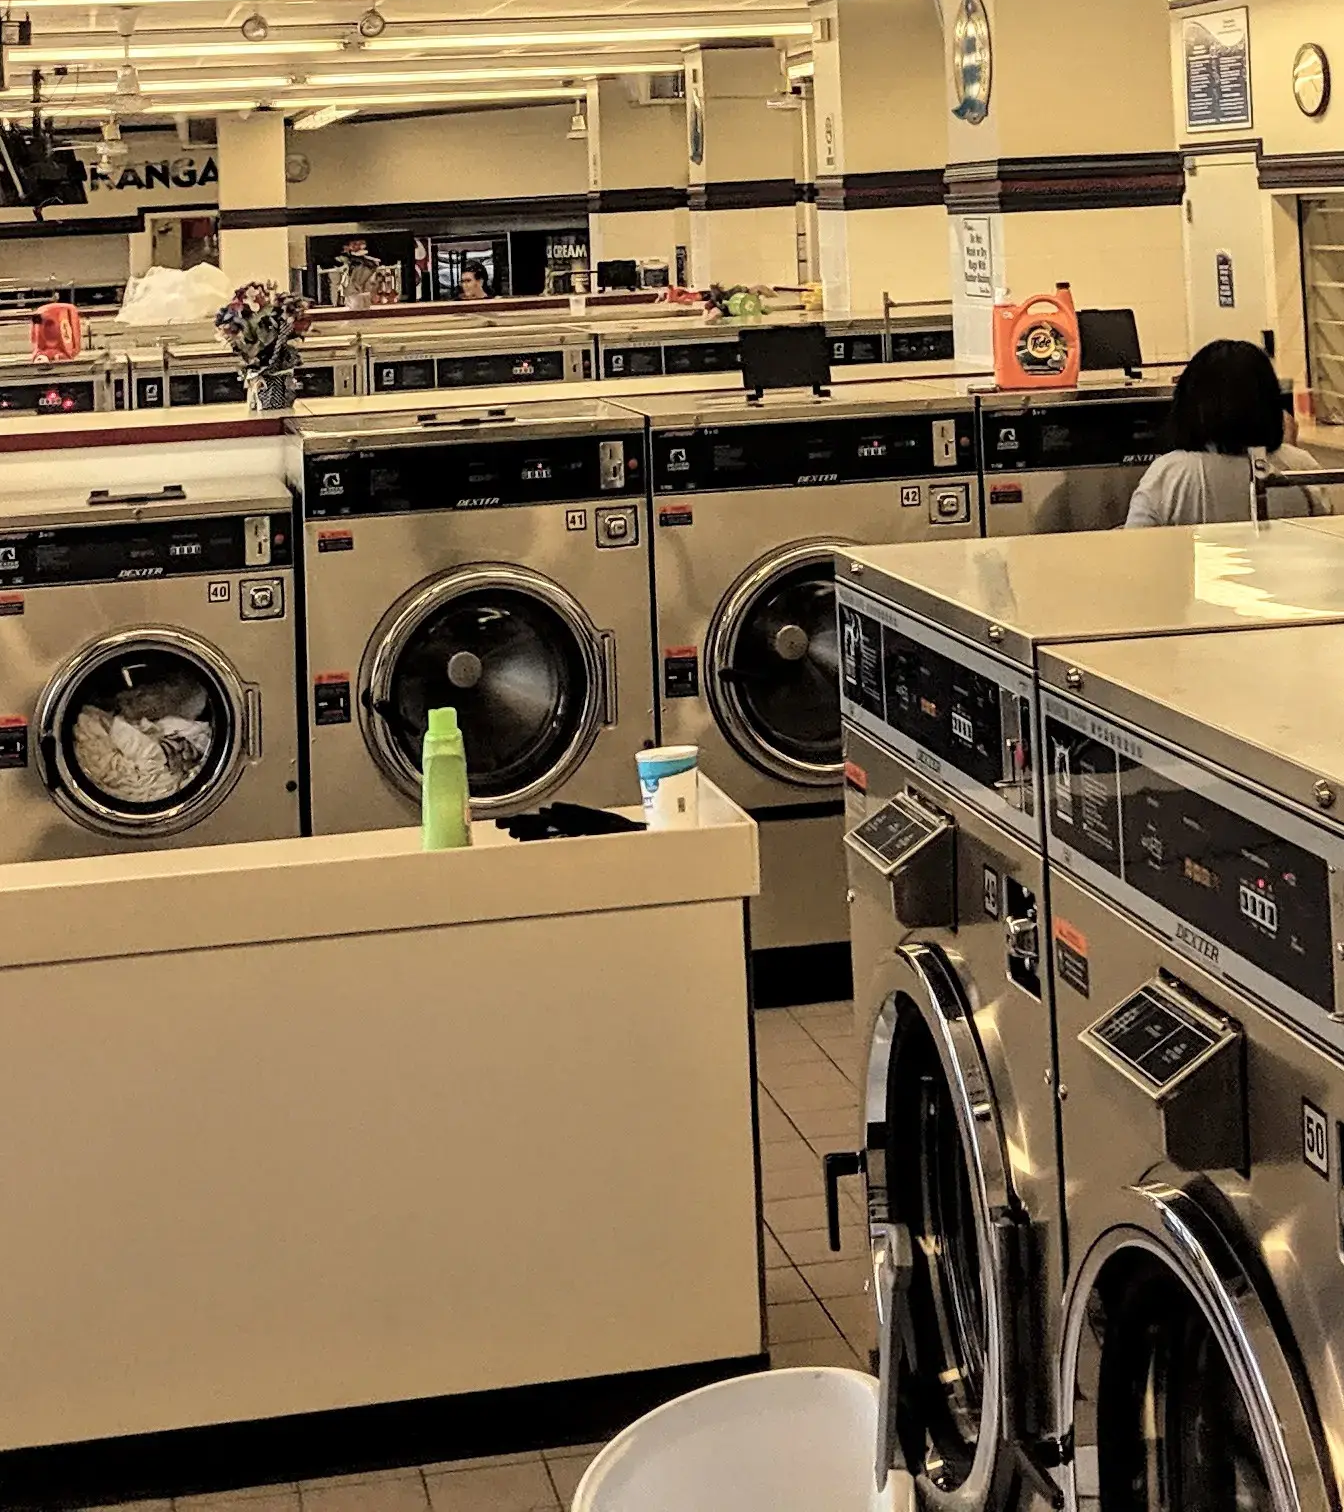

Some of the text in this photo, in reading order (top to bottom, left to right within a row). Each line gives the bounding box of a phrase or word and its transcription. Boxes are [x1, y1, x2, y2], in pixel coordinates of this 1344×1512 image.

[553, 244, 587, 258] CREAM
[1031, 335, 1052, 352] Tide
[456, 497, 500, 507] DEXTER
[904, 489, 918, 502] 42
[569, 514, 584, 527] 41
[117, 567, 164, 578] DEXTER
[212, 585, 227, 598] 40
[1175, 922, 1221, 963] DEXTER
[1306, 1115, 1325, 1160] 50
